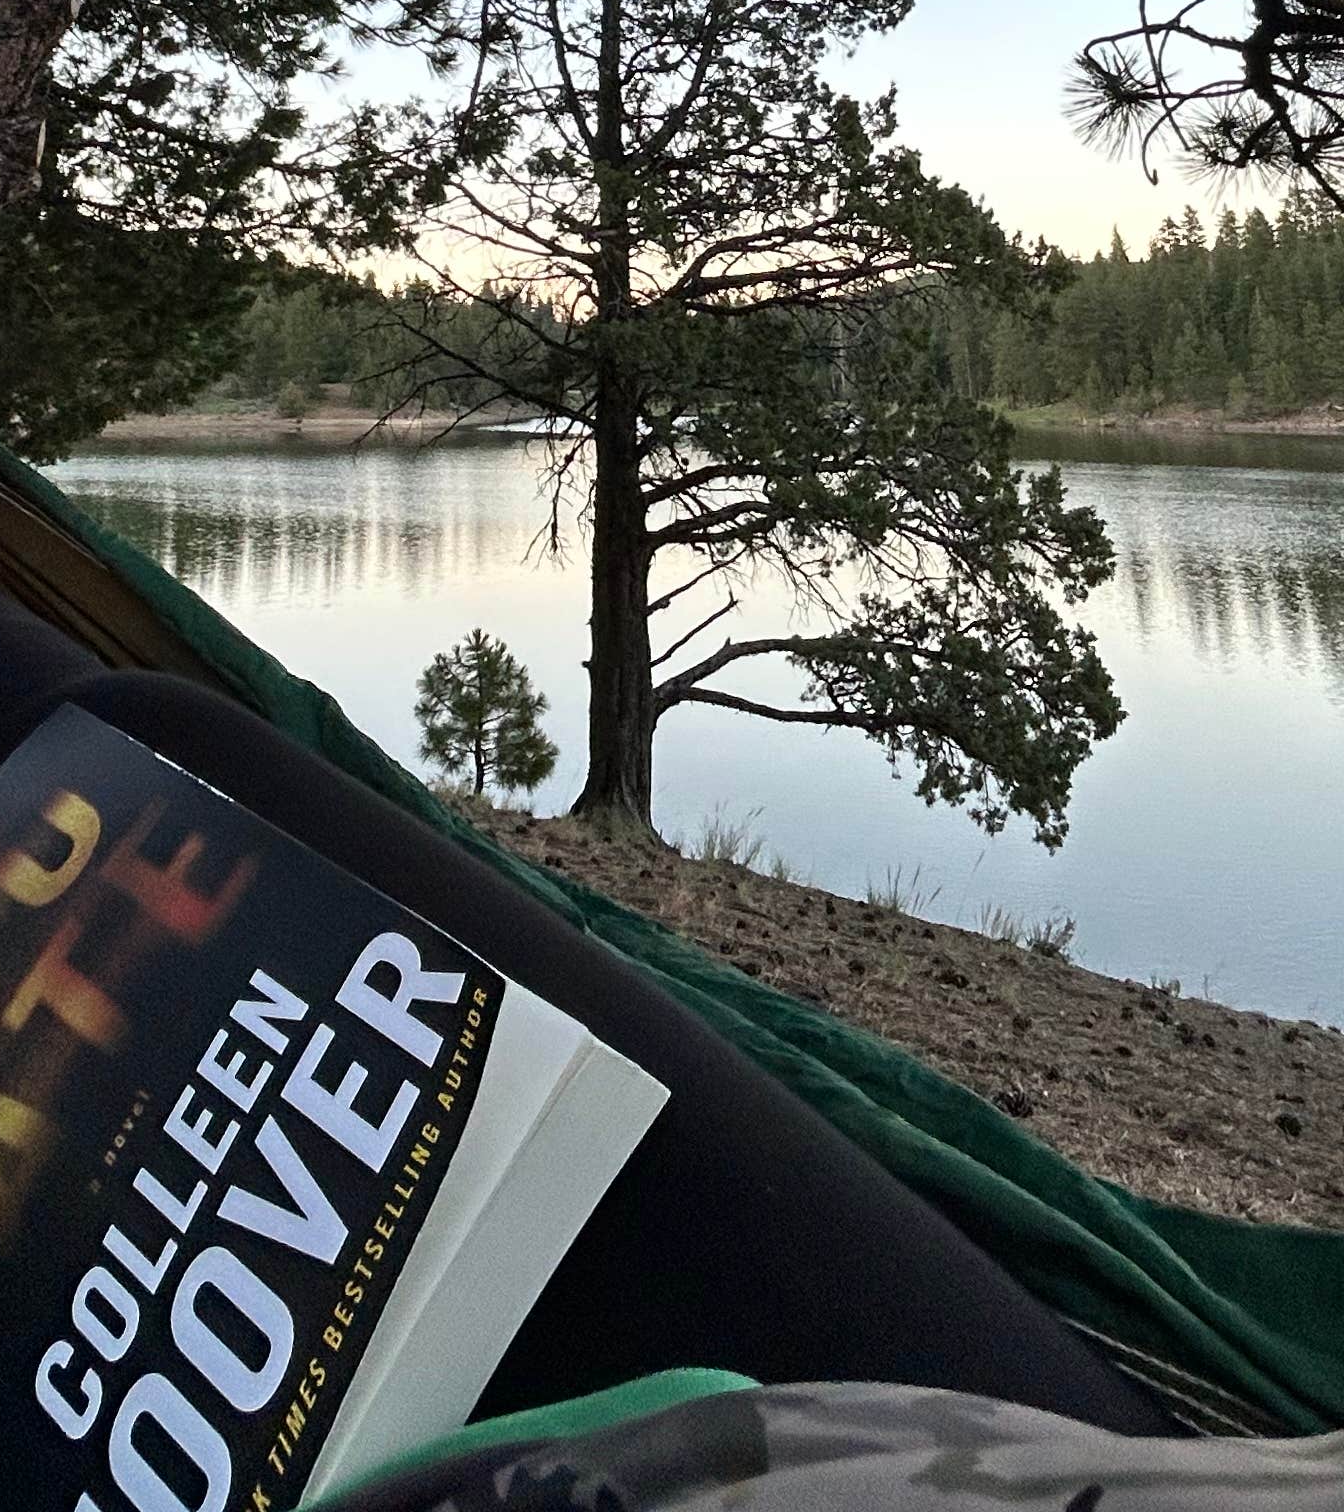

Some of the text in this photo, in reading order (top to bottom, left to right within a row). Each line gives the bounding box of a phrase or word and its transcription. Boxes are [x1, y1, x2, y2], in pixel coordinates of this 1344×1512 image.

[34, 968, 309, 1440] COLLEEN
[73, 931, 467, 1512] OOVER
[267, 987, 488, 1476] TIMES BESTSELLING AUTHOR
